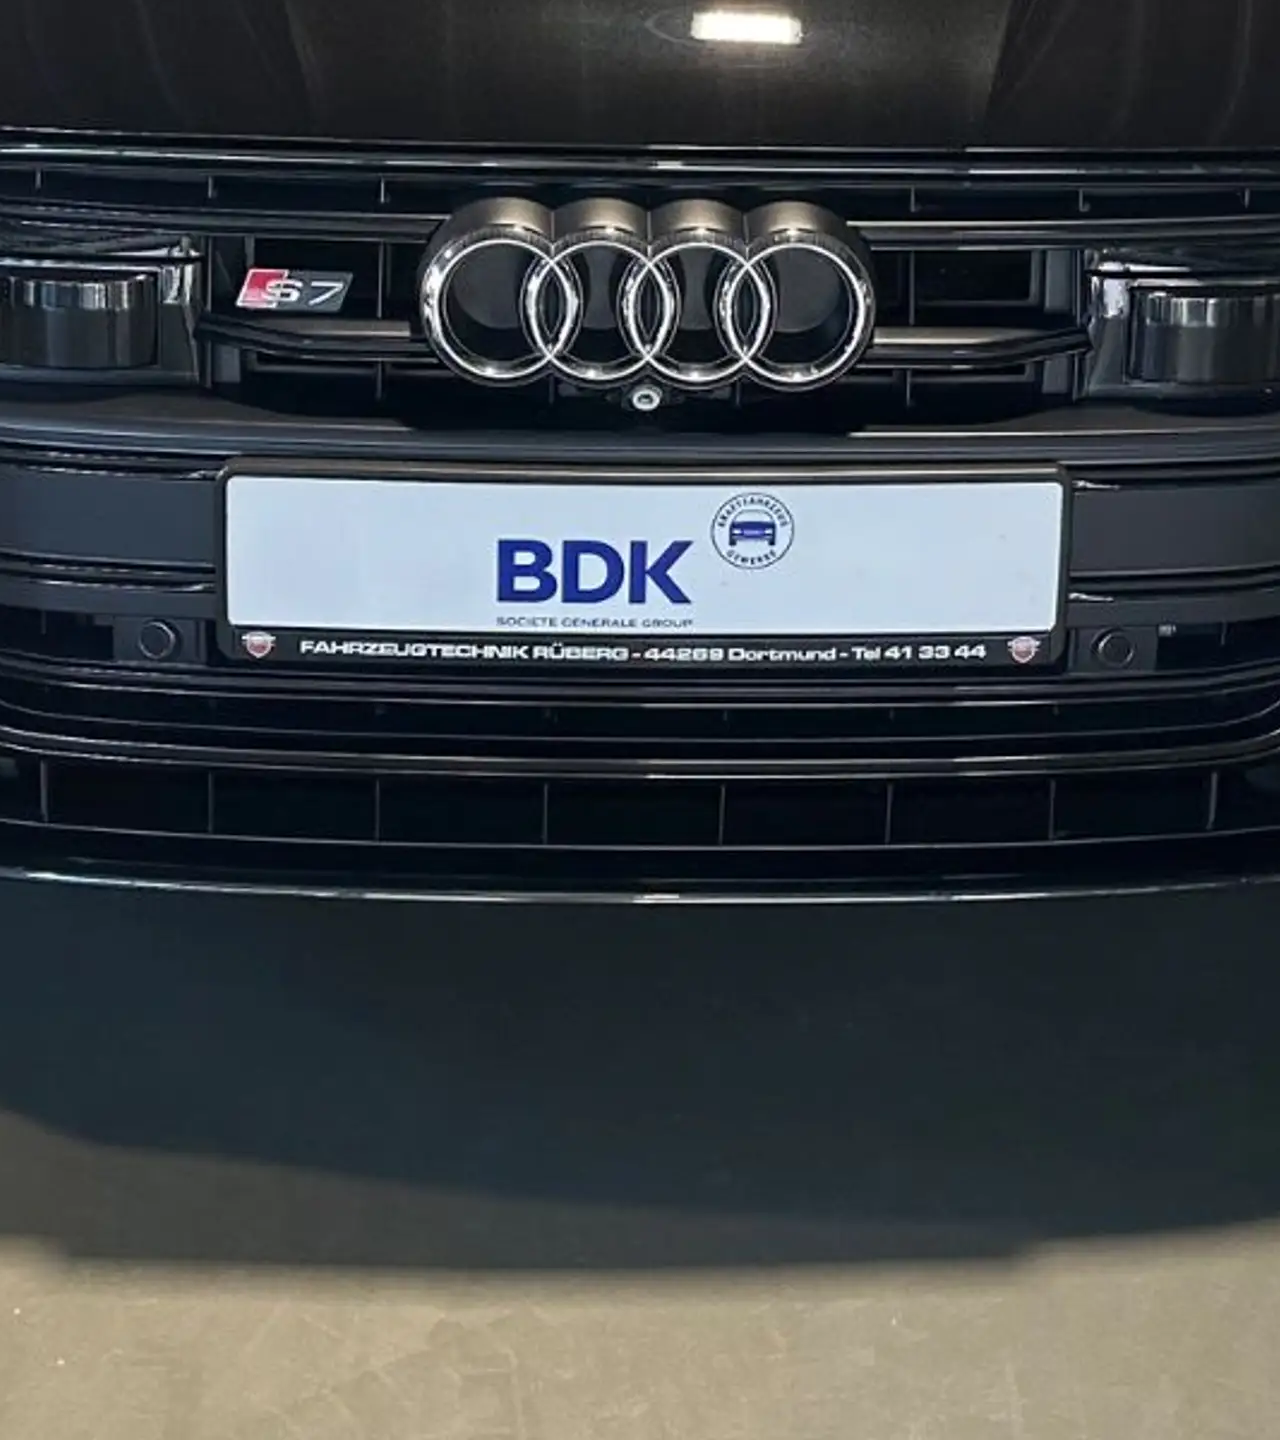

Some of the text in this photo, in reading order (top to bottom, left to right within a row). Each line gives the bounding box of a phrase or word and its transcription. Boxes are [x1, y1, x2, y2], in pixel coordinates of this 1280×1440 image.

[261, 279, 344, 306] S7
[497, 539, 694, 604] BDK
[299, 640, 530, 660] FAHRZEUGTECHNIK
[728, 646, 837, 662] Dortmund
[851, 646, 881, 661] Tel
[884, 646, 912, 660] 41
[918, 645, 951, 659] 33
[954, 645, 987, 659] 44
